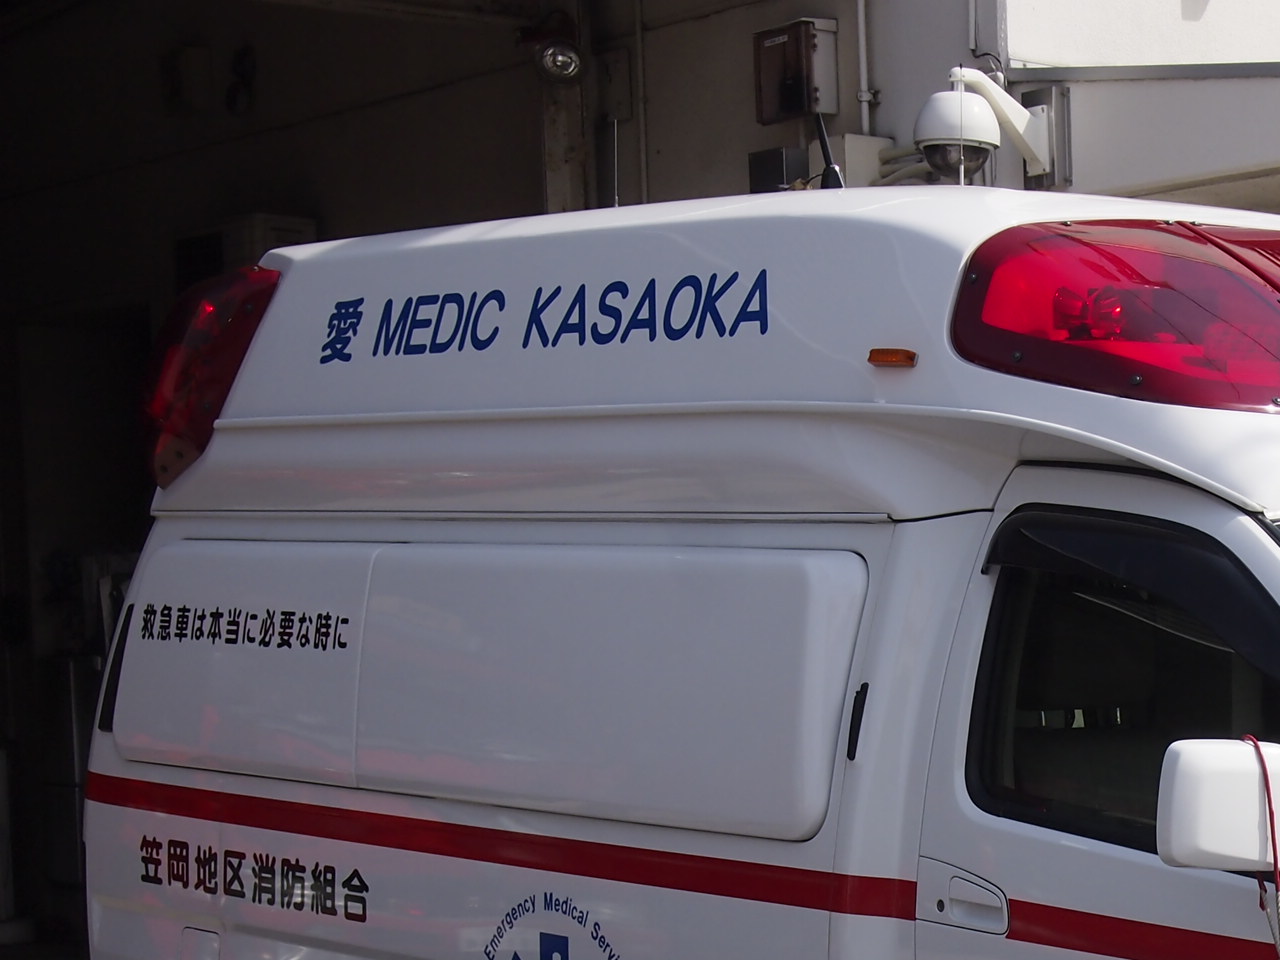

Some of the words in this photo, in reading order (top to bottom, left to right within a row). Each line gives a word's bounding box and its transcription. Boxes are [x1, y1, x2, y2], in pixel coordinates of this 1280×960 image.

[320, 297, 364, 365] 愛
[372, 289, 506, 358] MEDIC
[522, 268, 768, 349] KASAOKA
[141, 603, 350, 651] 救急車は本当に必要な時に
[139, 834, 369, 923] 笠岡地区消防組合
[543, 891, 589, 928] Medical
